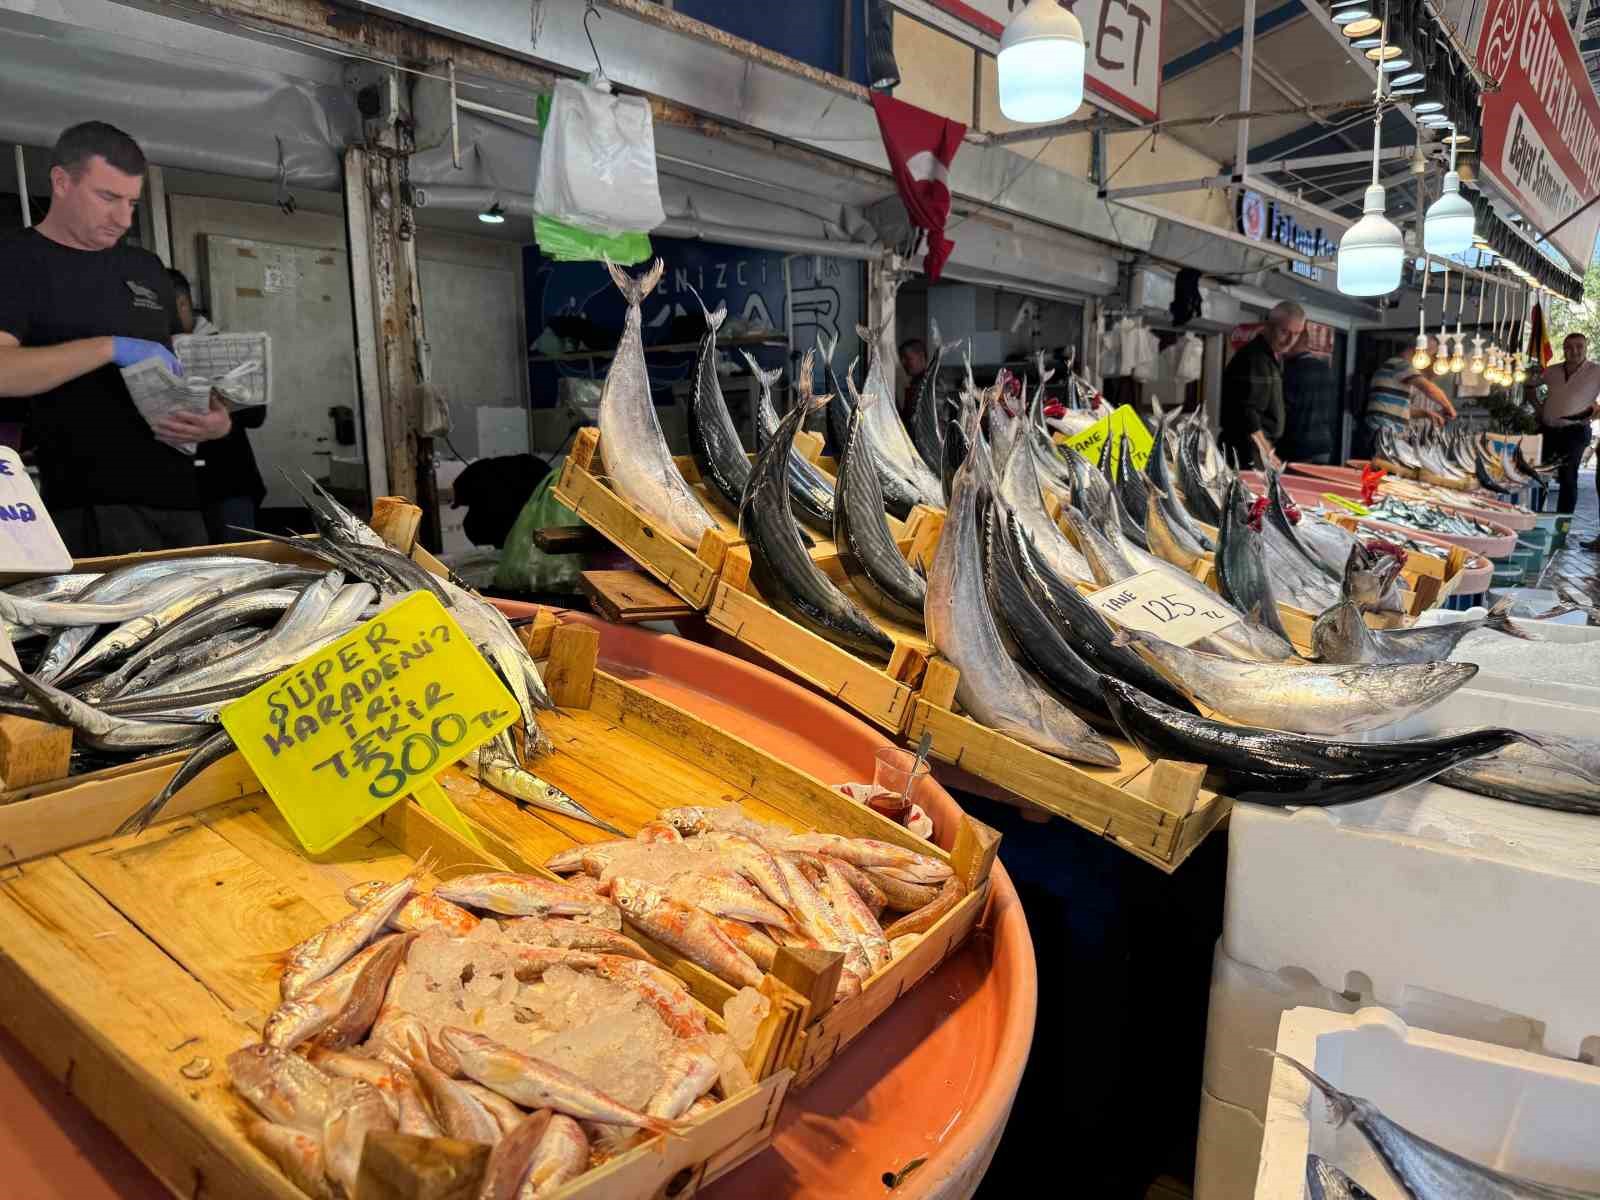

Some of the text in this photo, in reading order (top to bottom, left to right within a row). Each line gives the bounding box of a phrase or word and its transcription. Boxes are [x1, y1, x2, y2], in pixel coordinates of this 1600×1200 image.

[1141, 593, 1225, 623] 125 TL
[267, 622, 400, 725] SÜPER
[369, 708, 509, 798] 300 TL
